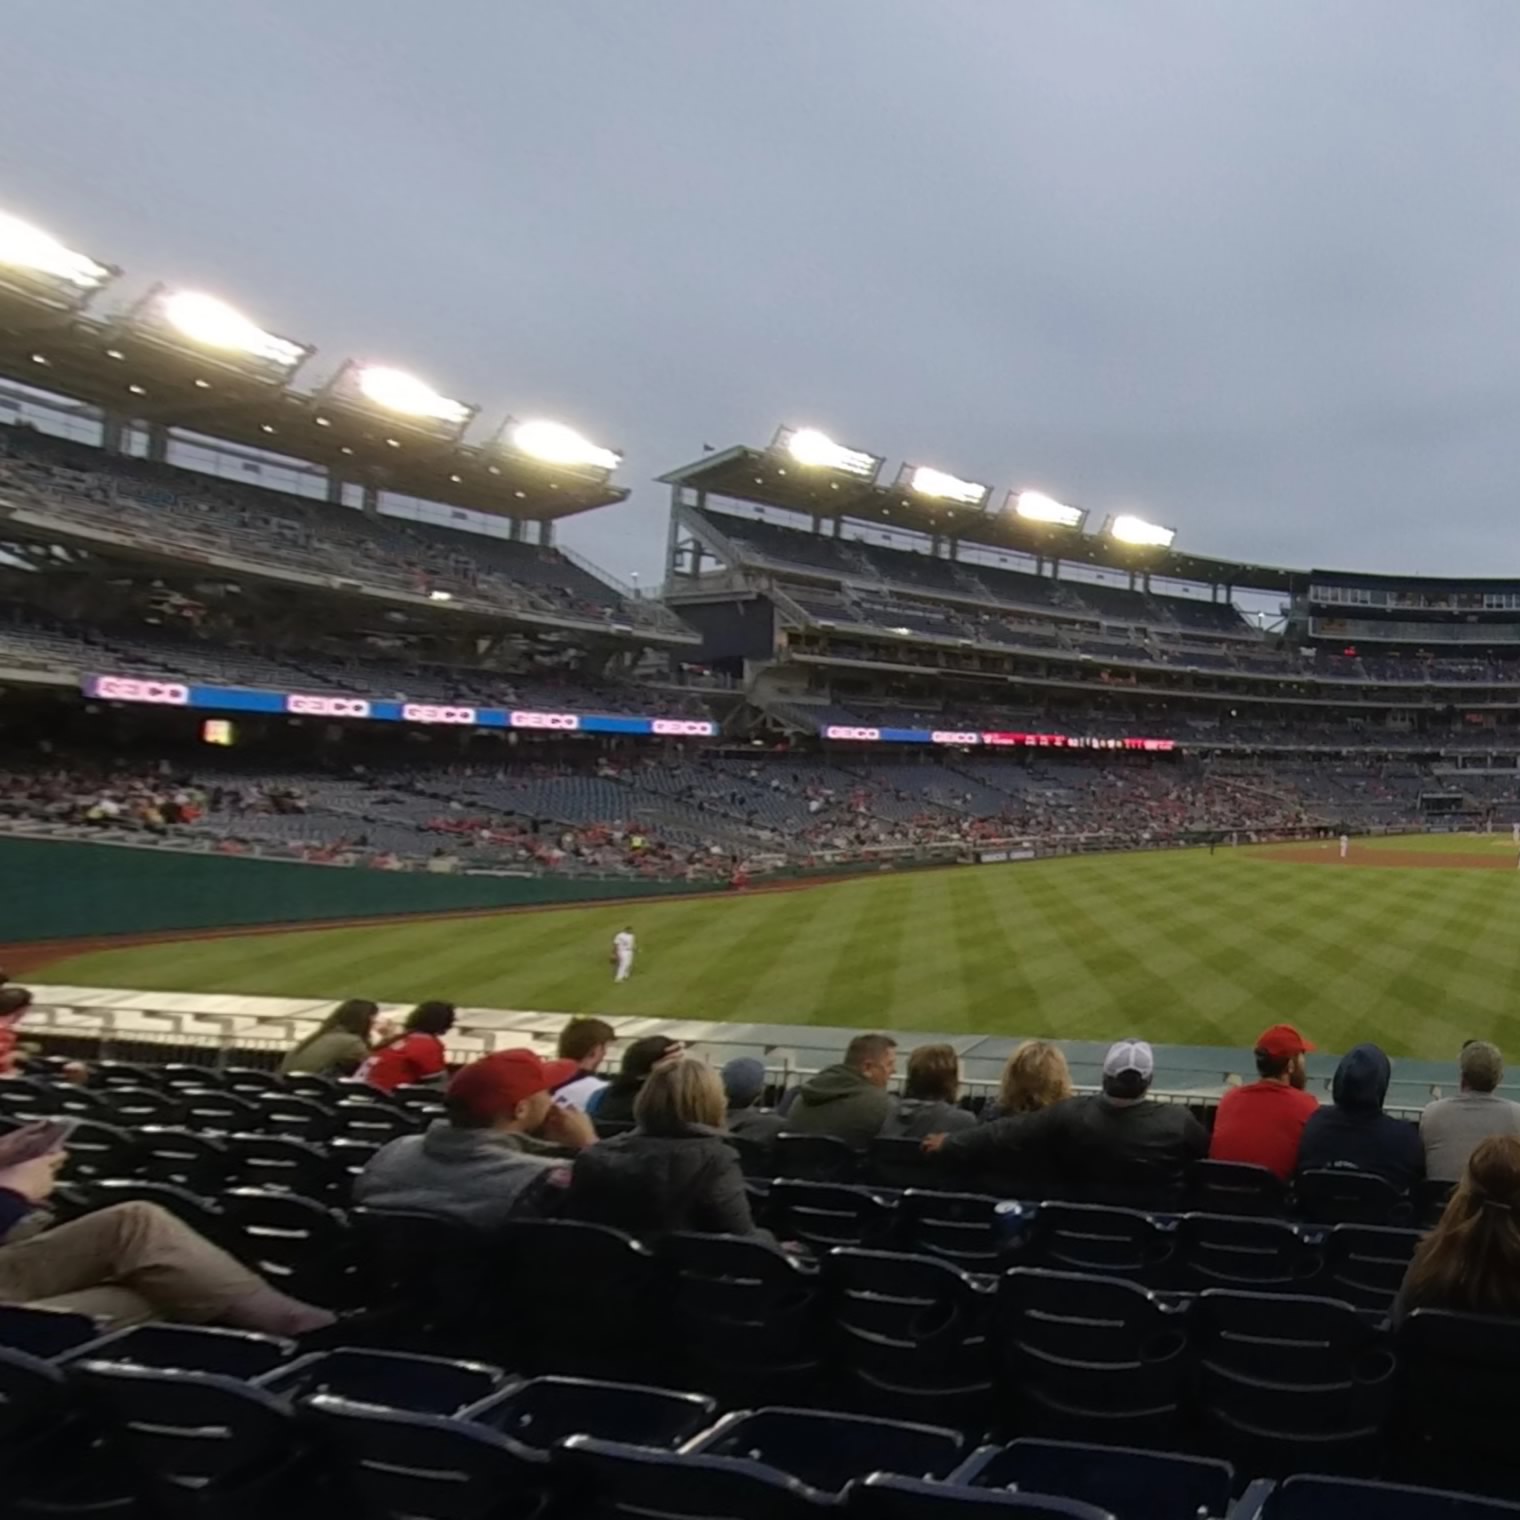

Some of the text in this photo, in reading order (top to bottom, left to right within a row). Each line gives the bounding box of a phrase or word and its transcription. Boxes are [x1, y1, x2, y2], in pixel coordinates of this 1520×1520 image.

[97, 676, 188, 704] GEICO
[288, 694, 369, 717] GEICO
[403, 704, 475, 723] GEICO
[510, 711, 578, 729] GEICO
[652, 719, 712, 735] GEICO
